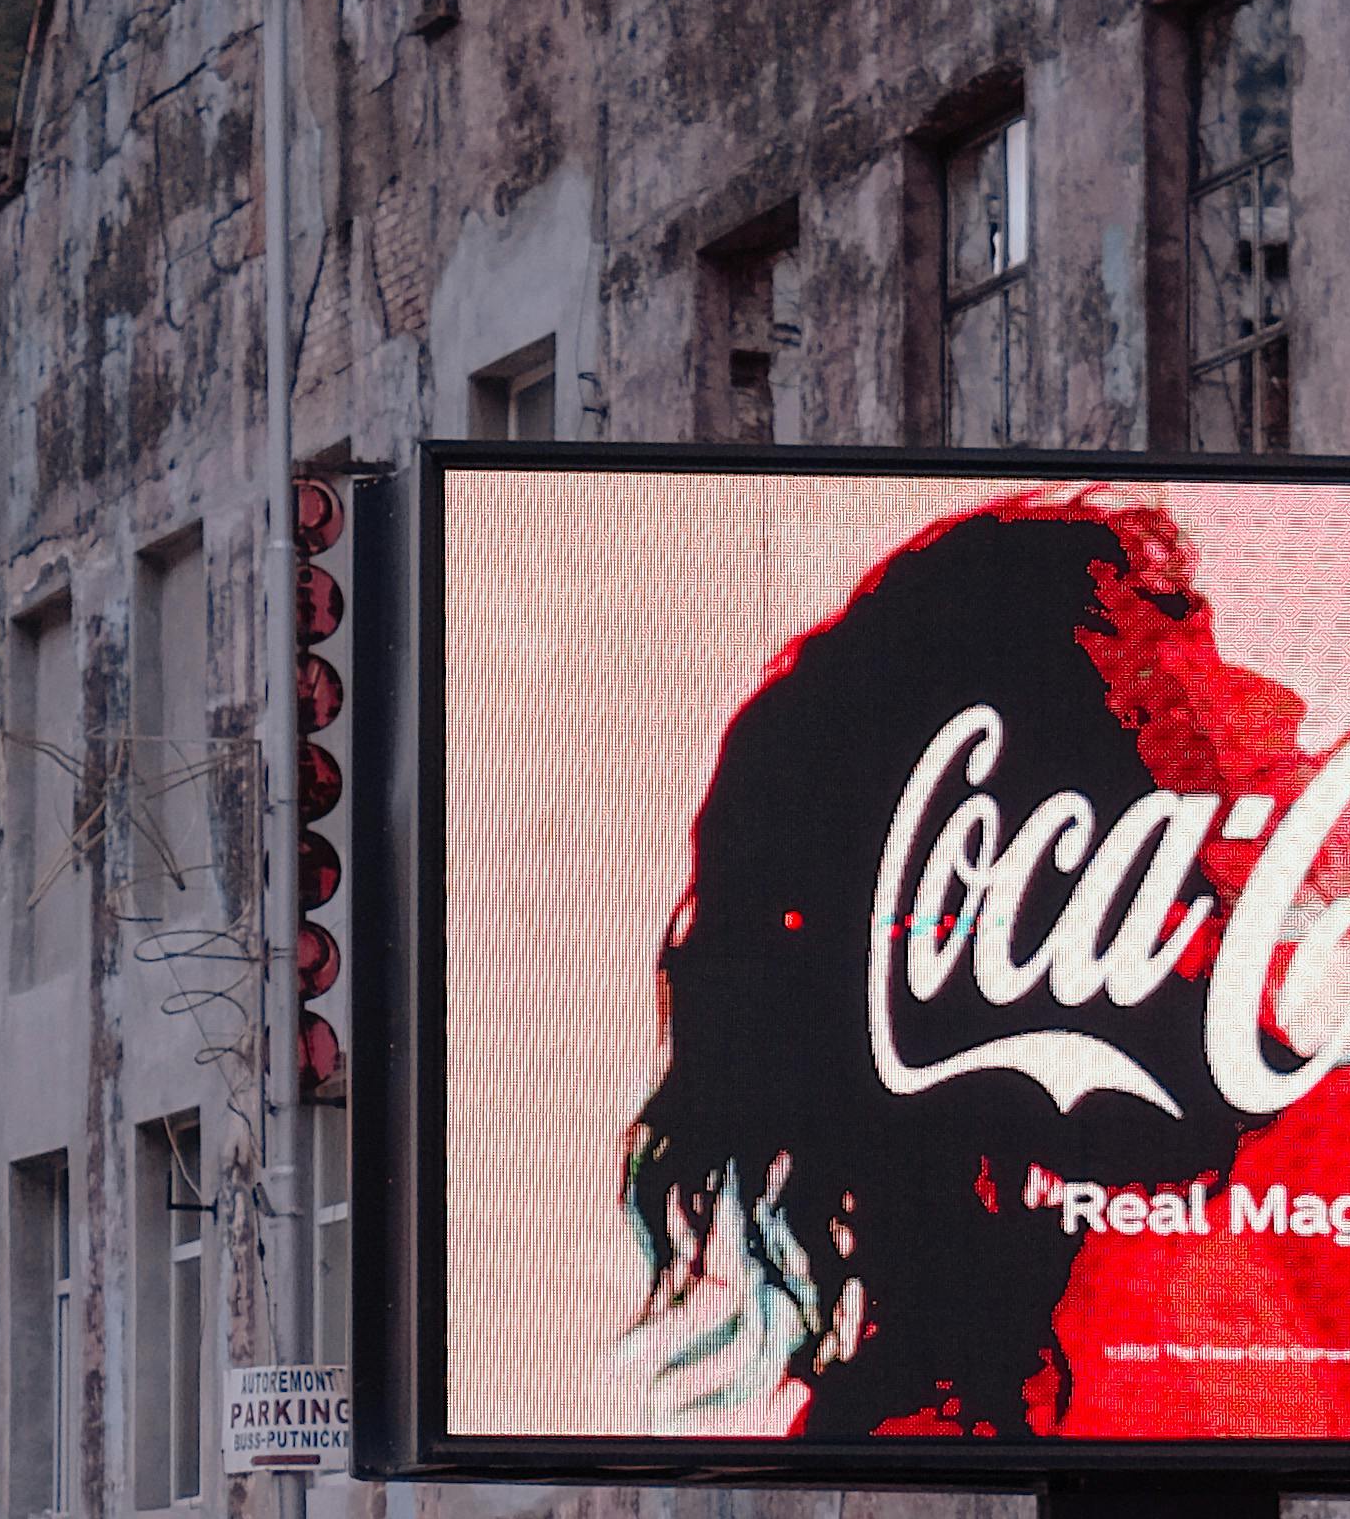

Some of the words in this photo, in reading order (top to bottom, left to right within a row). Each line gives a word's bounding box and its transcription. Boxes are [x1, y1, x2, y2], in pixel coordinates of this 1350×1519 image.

[1062, 1181, 1210, 1235] Real
[241, 1370, 335, 1394] AUTOREMONT
[230, 1398, 349, 1429] PARKING
